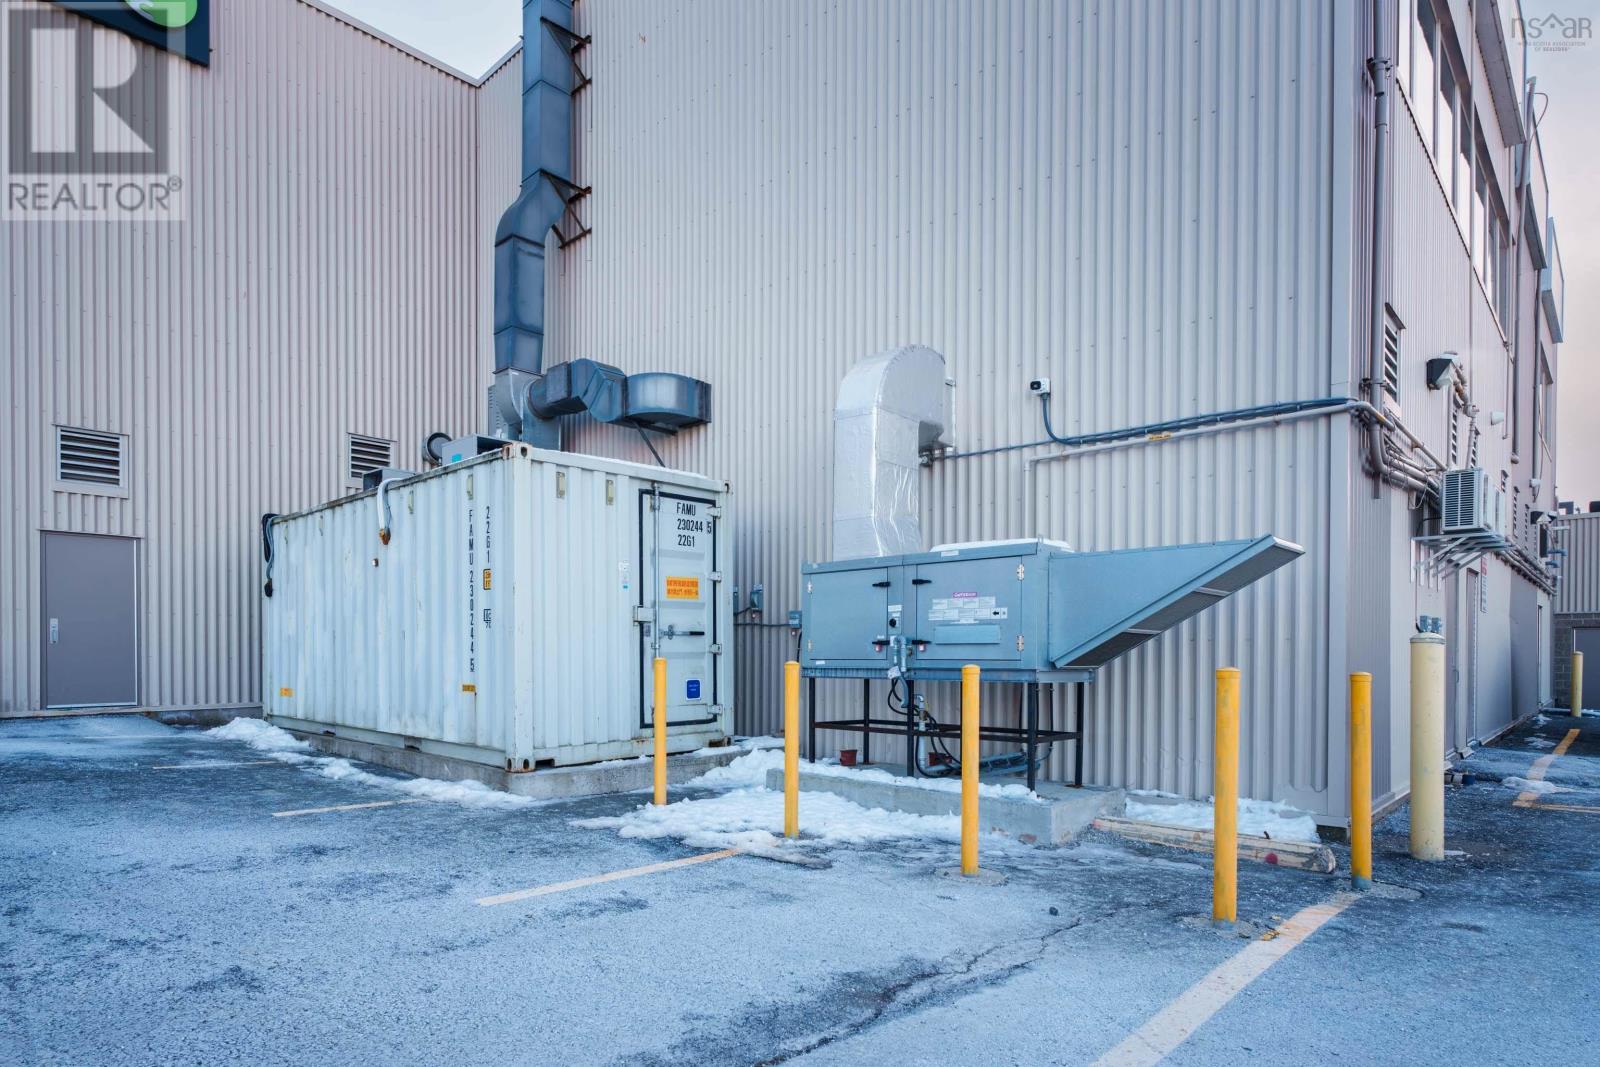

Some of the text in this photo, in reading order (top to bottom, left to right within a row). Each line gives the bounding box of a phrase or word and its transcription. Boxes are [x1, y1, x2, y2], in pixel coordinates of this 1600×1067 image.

[676, 502, 696, 516] FAMU
[677, 518, 712, 534] 230244 5
